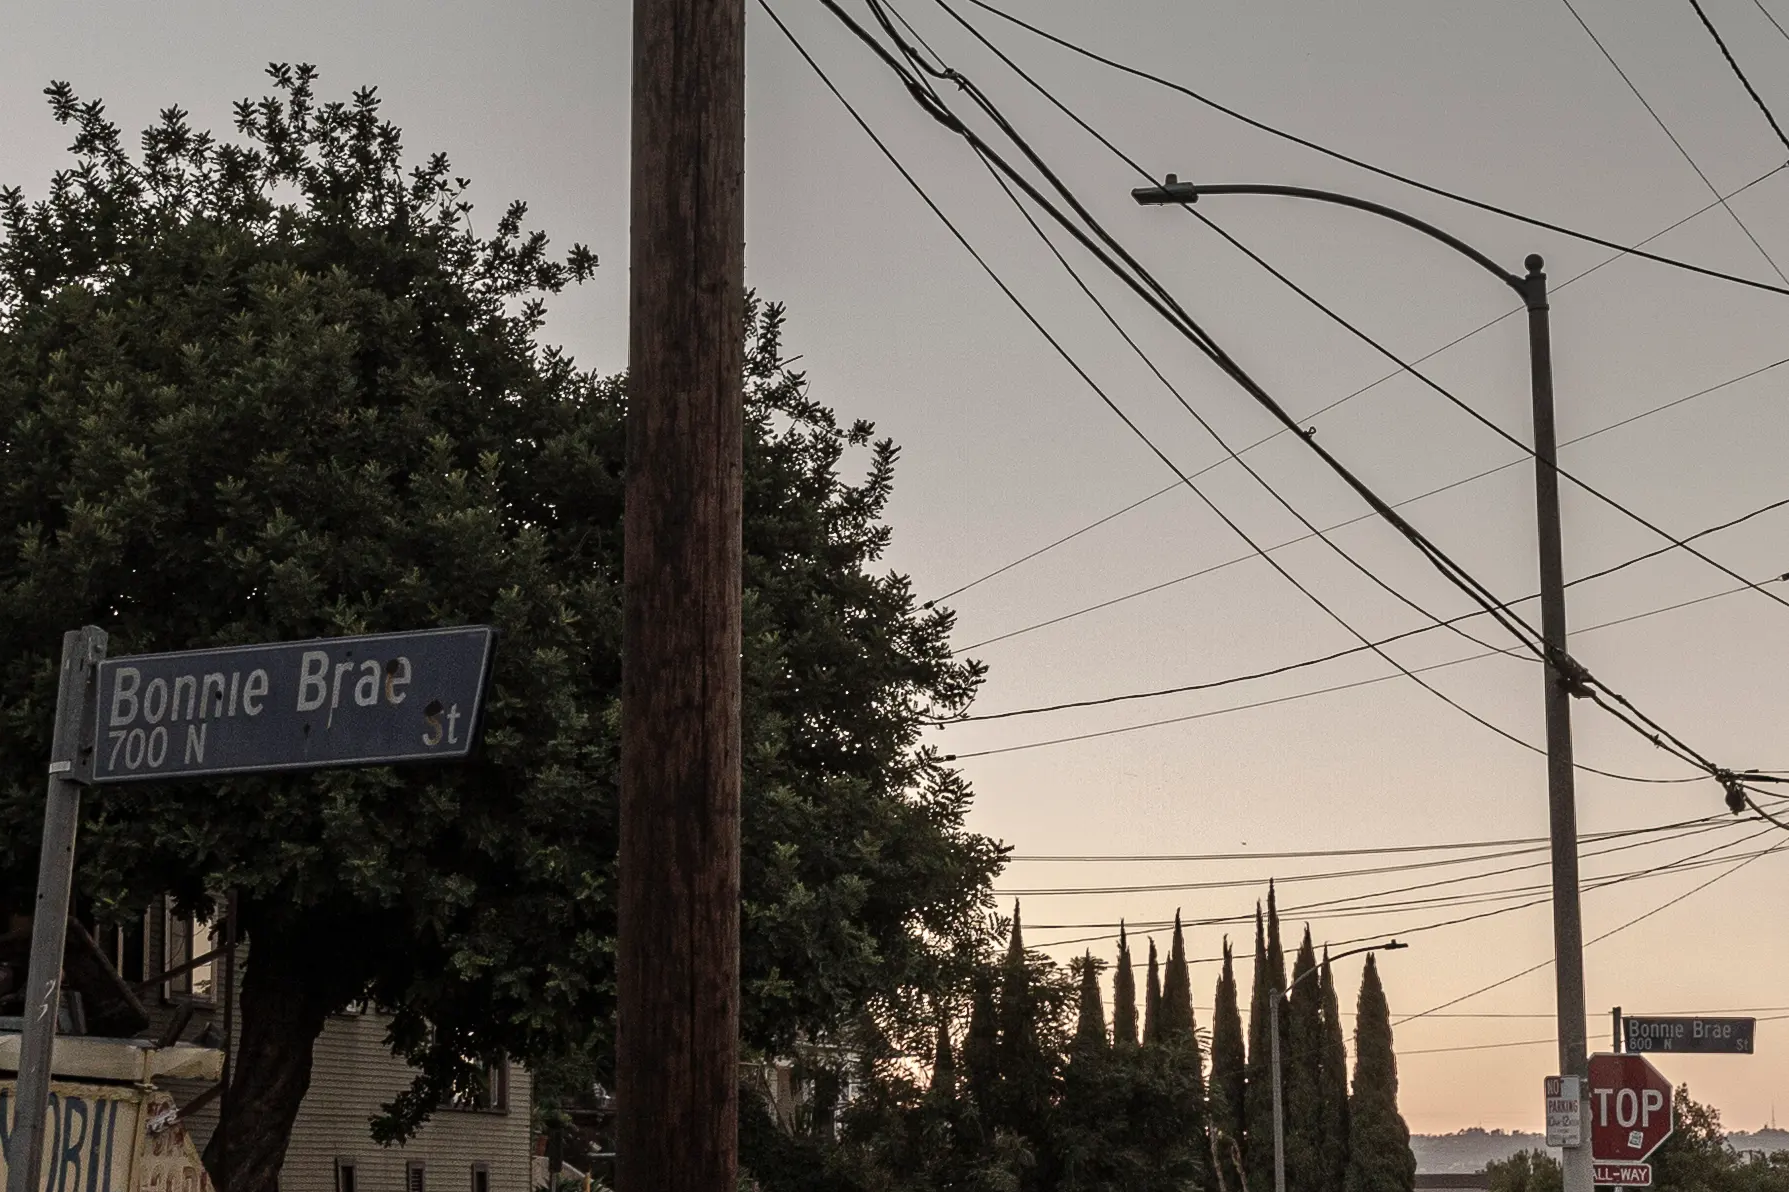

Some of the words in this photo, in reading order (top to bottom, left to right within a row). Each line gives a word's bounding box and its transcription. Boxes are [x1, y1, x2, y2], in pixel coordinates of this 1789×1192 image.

[109, 666, 270, 726] Bonnie
[296, 650, 413, 714] Brae
[422, 702, 461, 747] St
[108, 726, 169, 771] 700
[184, 723, 208, 765] N
[1629, 1020, 1684, 1038] Bonnie
[1693, 1020, 1732, 1038] Brae
[1664, 1039, 1672, 1050] N
[1736, 1039, 1749, 1051] St
[1547, 1080, 1560, 1095] NO
[1548, 1100, 1578, 1113] PARKING
[1590, 1088, 1663, 1127] TOP
